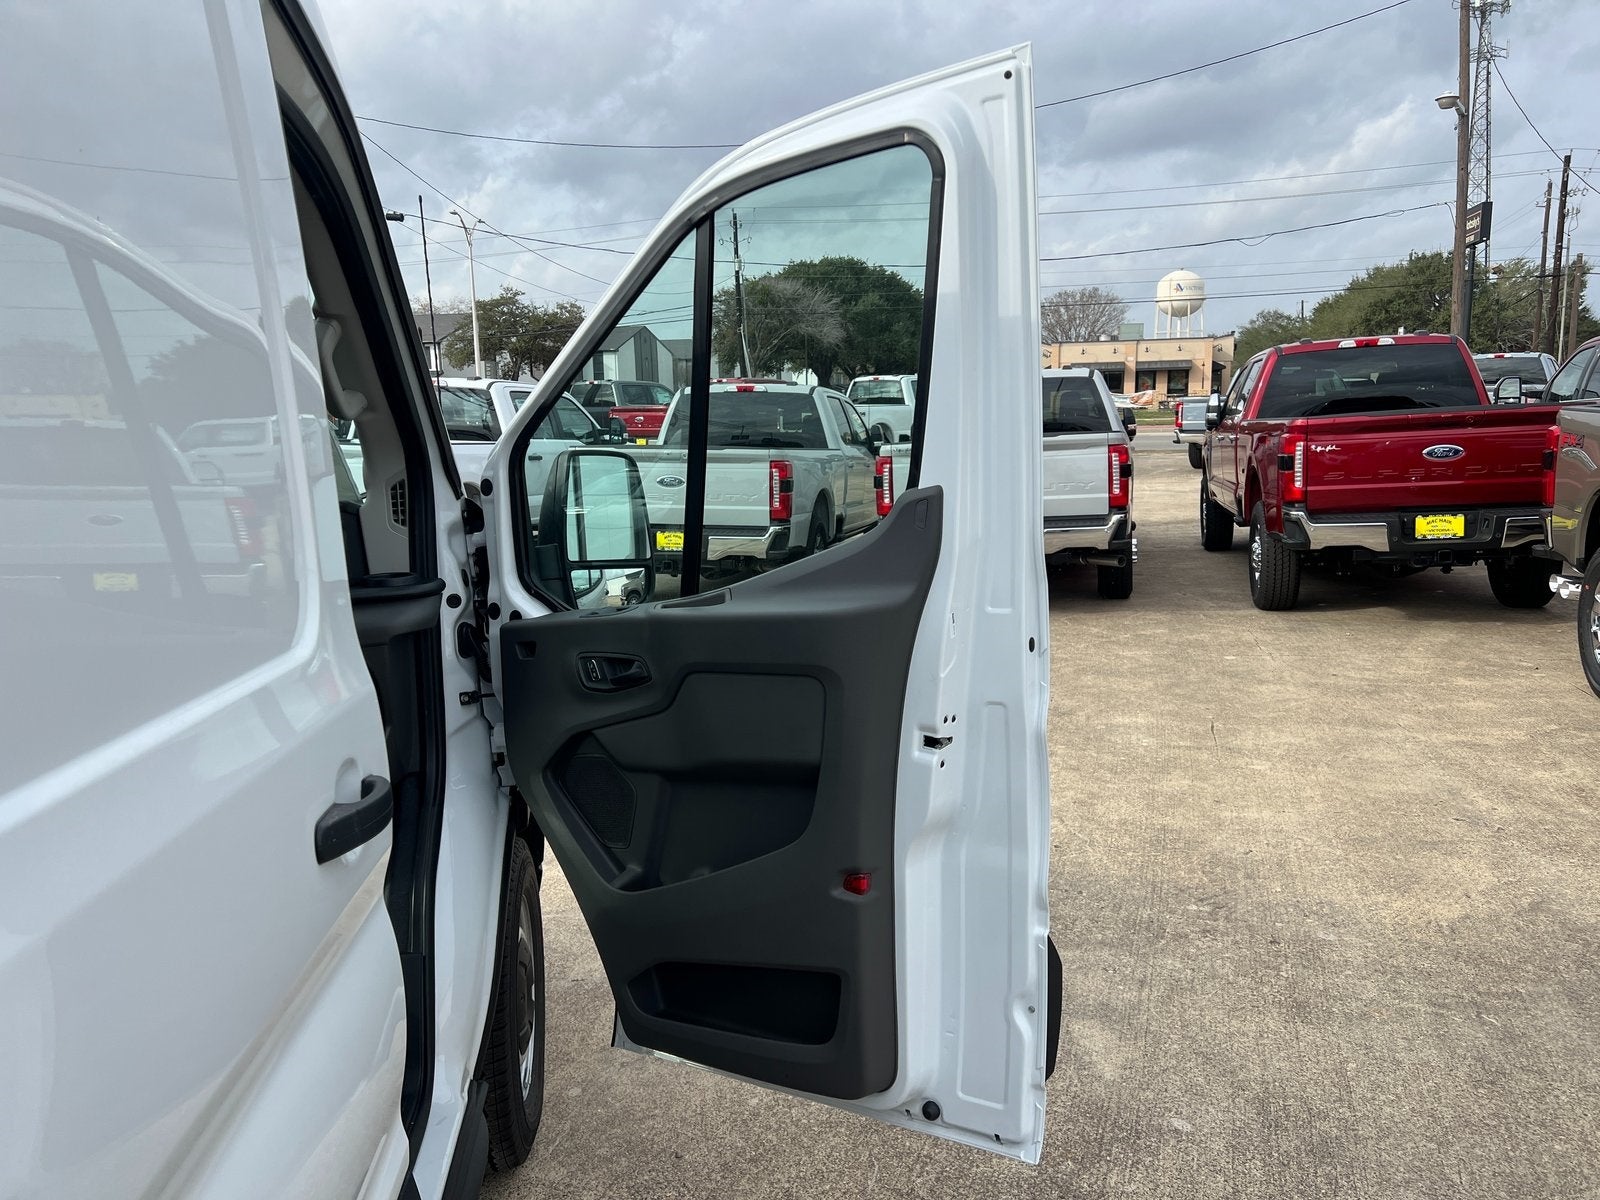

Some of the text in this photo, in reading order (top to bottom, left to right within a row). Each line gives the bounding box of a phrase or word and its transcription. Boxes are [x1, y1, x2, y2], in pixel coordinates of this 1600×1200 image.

[1560, 432, 1584, 448] FX4
[1322, 463, 1544, 481] SUPER DUT
[1042, 480, 1096, 491] UTY
[706, 492, 761, 503] UTY
